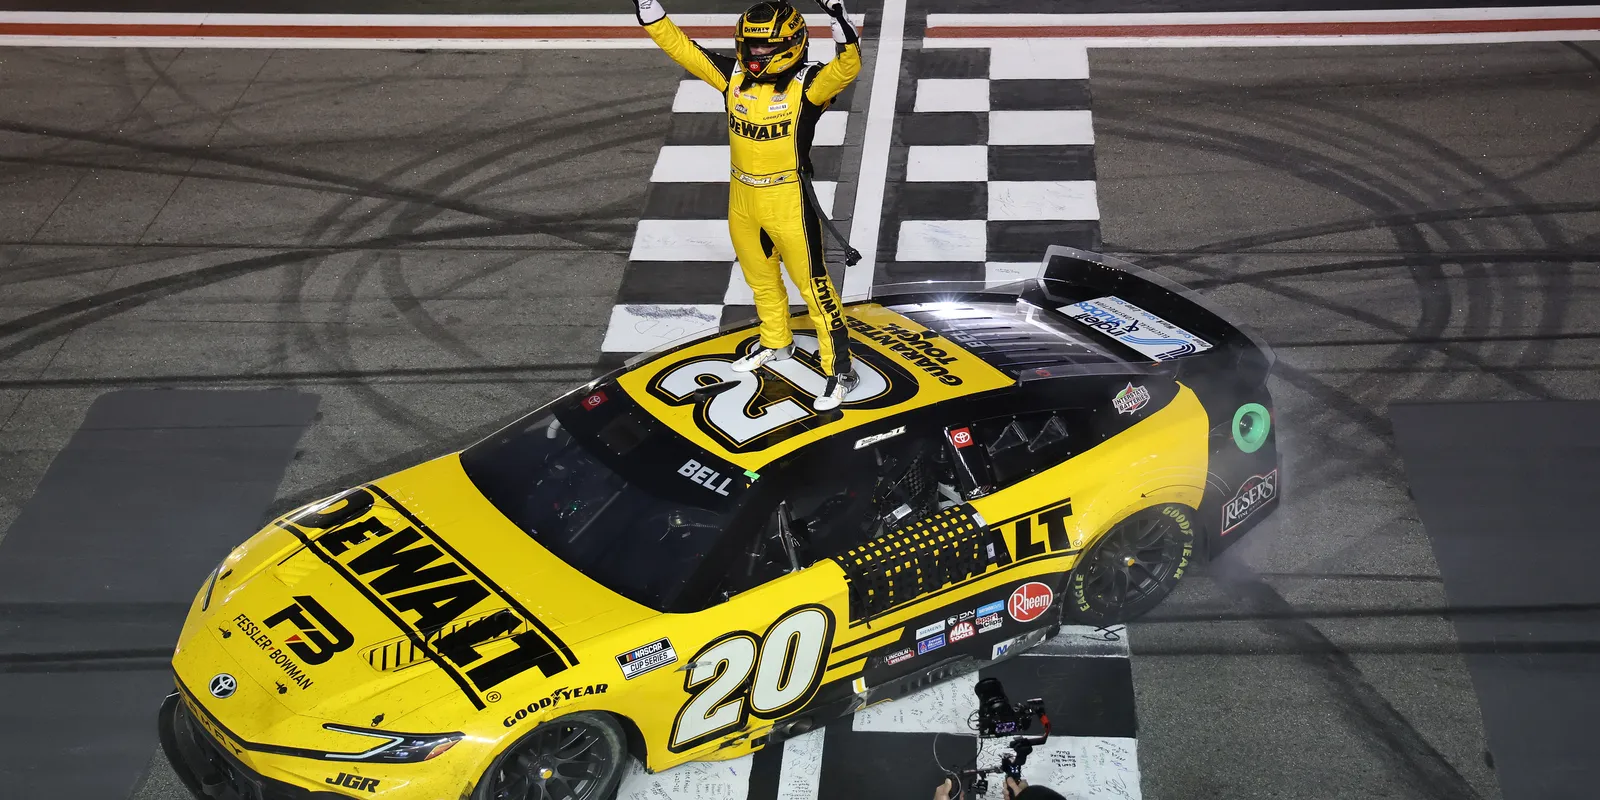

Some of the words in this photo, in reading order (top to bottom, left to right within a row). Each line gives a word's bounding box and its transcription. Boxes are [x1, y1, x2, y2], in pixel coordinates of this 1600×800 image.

[845, 314, 963, 387] GUARANTEE
[1115, 387, 1146, 406] INTERSTATE
[1119, 393, 1149, 410] BATTERIES
[677, 458, 733, 497] BELL
[1012, 585, 1050, 617] Rheem
[1073, 573, 1091, 612] EAGLE
[959, 608, 976, 619] DN
[919, 624, 943, 636] SIEMENS
[950, 622, 973, 638] MAC
[950, 630, 974, 643] TOOLS
[232, 613, 280, 651] FESSLER
[269, 650, 313, 691] BOWMAN
[634, 642, 663, 659] NASCAR
[885, 648, 910, 661] LINCOLN
[630, 660, 644, 672] CUP
[644, 651, 668, 667] SERIES
[669, 604, 834, 752] 20
[503, 683, 609, 729] GOODYEAR
[324, 771, 381, 795] JGR
